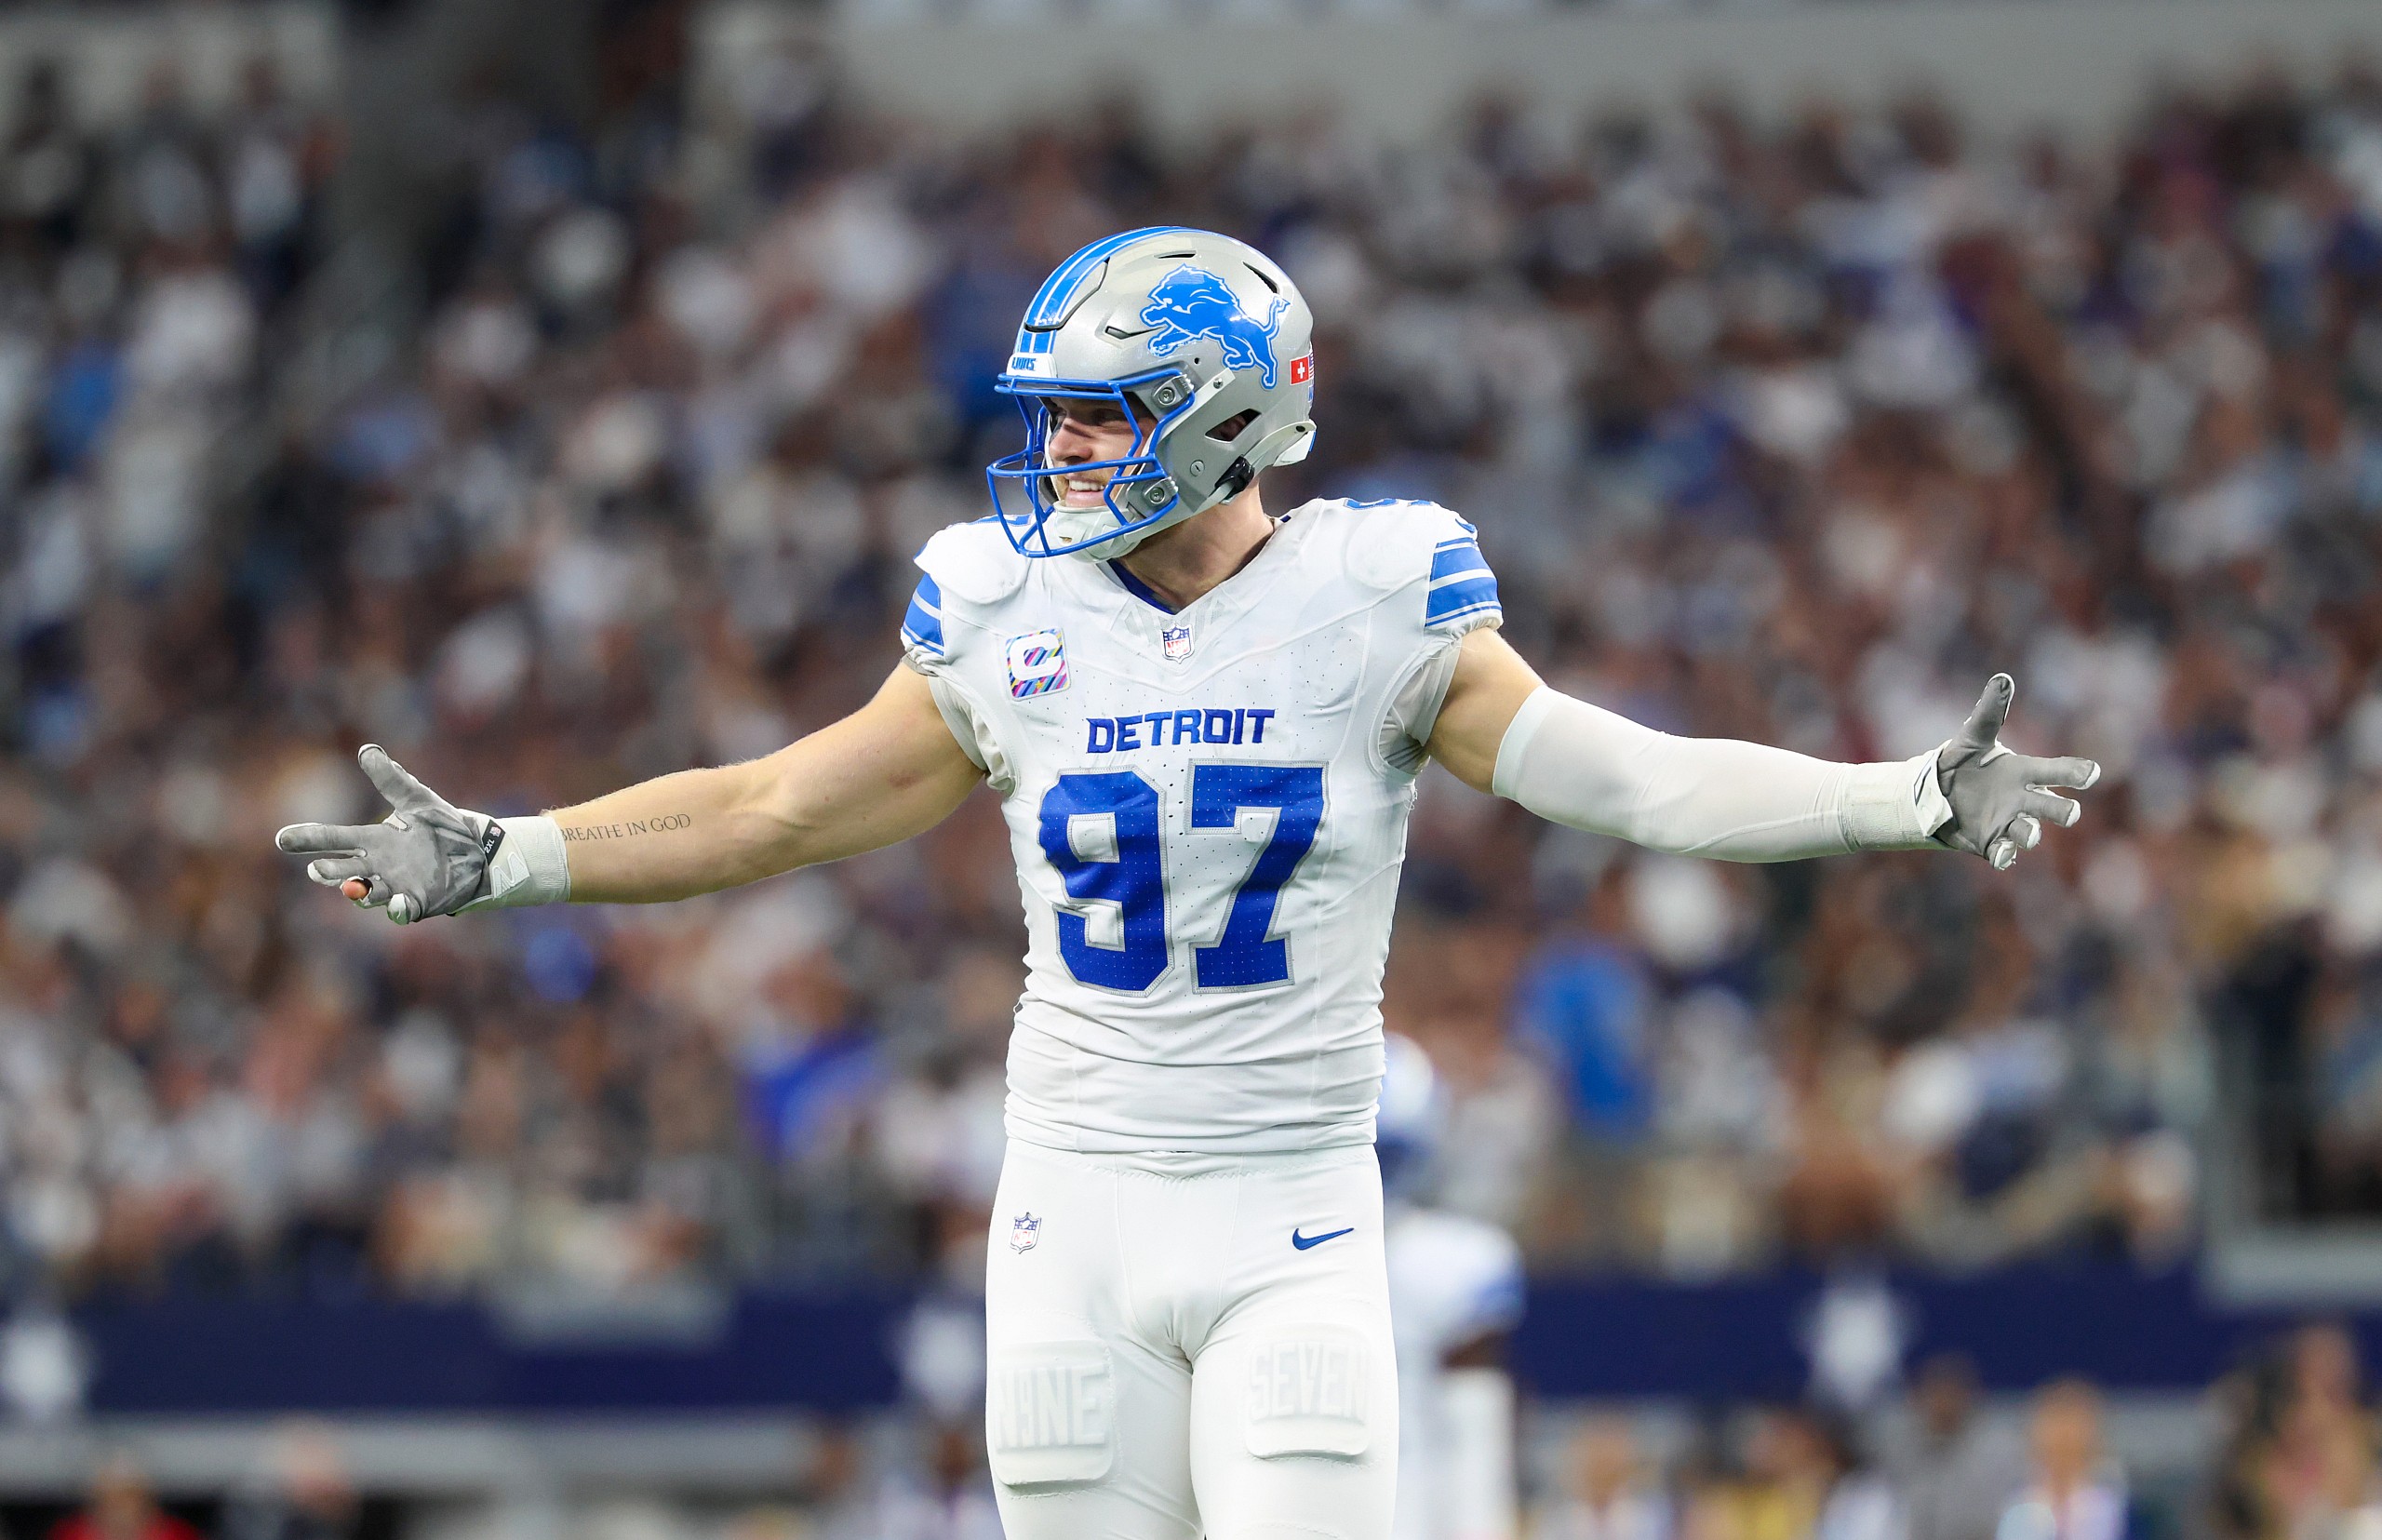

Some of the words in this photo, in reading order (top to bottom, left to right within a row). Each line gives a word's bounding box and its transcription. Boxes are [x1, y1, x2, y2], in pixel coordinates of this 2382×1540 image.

[1009, 633, 1062, 681] C
[1086, 708, 1276, 754] DETROIT
[484, 838, 495, 854] 2XL
[625, 820, 648, 836] IN
[650, 813, 691, 832] GOD
[1037, 758, 1330, 998] 97
[1250, 1341, 1371, 1425] SEVEN
